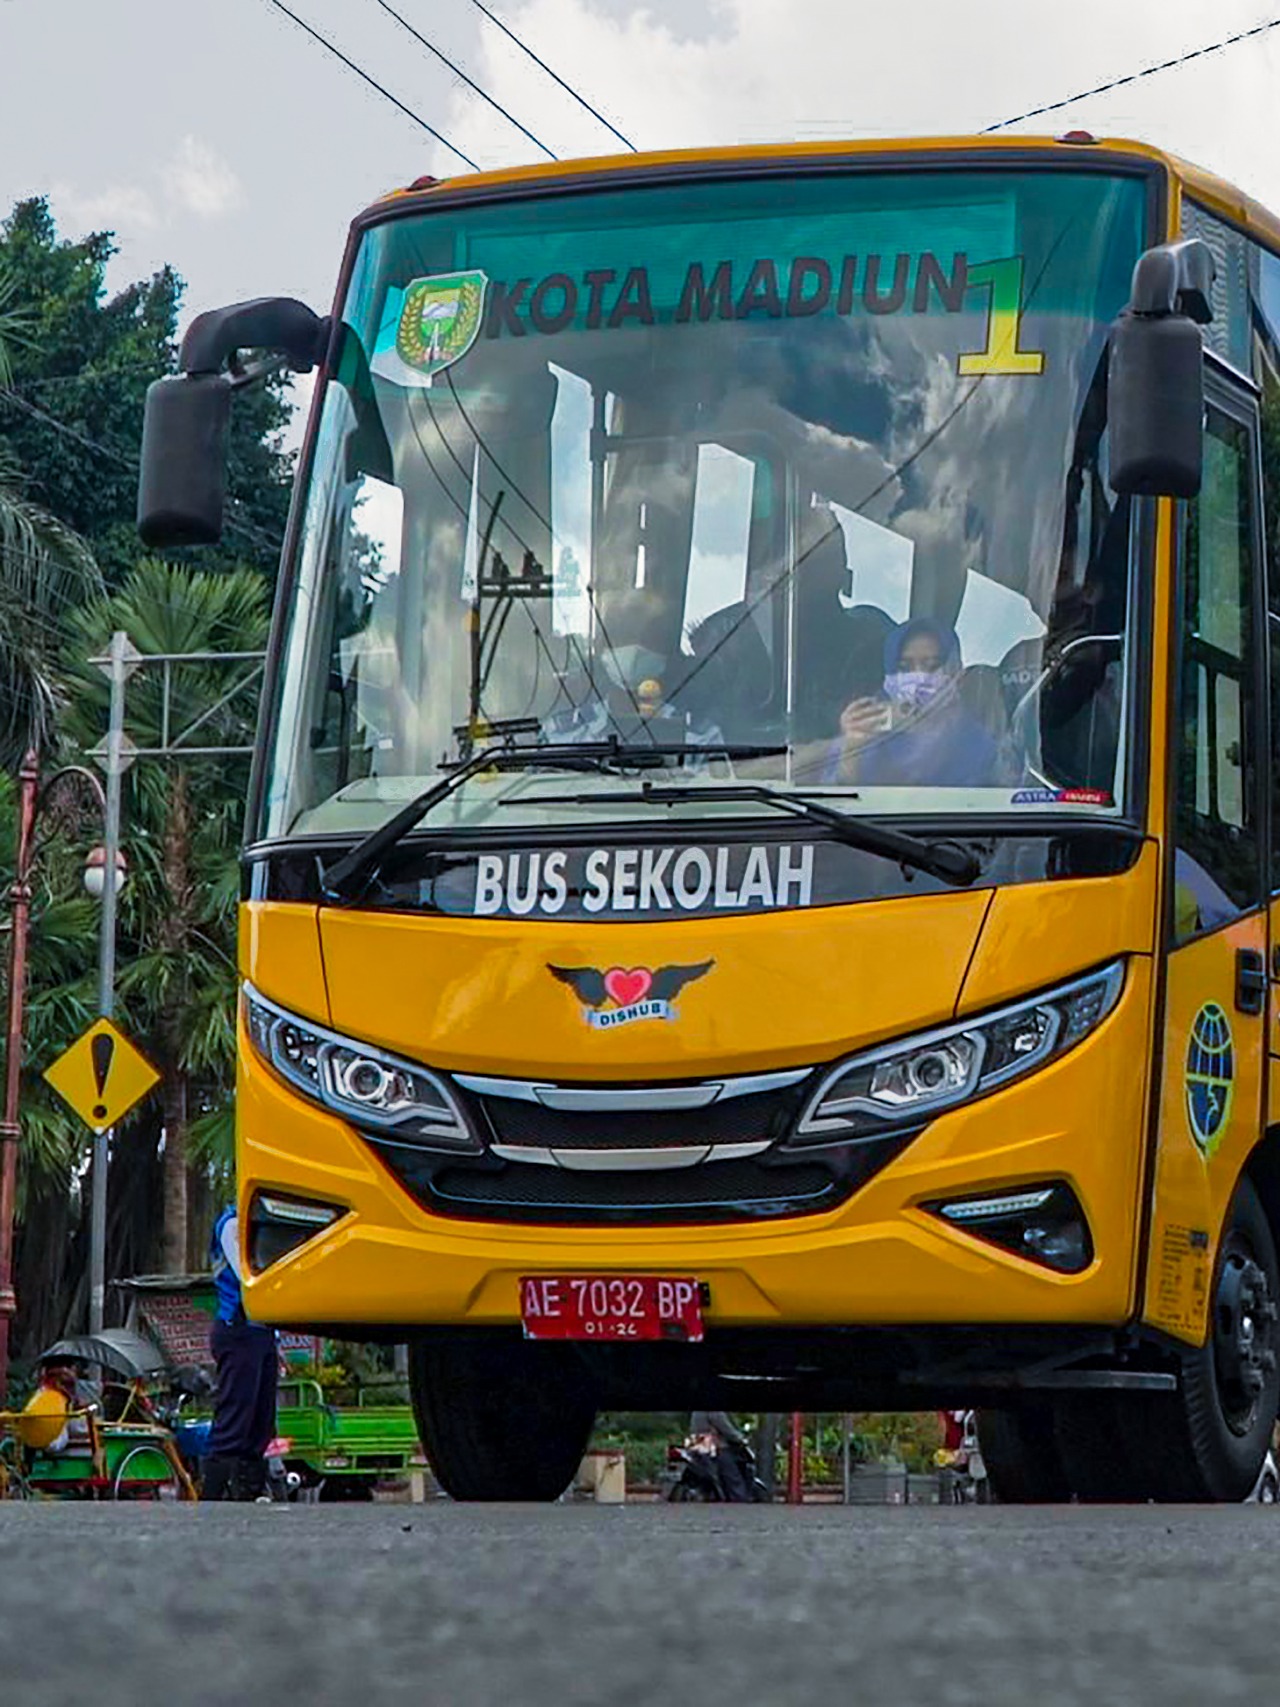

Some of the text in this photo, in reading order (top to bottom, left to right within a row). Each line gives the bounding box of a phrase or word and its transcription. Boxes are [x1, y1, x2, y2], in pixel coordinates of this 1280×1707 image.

[485, 251, 967, 339] KOTA MADIUN
[957, 255, 1044, 376] 1
[473, 845, 815, 915] BUS SEKOLAH
[599, 1002, 662, 1027] DISHUB
[524, 1279, 693, 1319] AE 7032 BP
